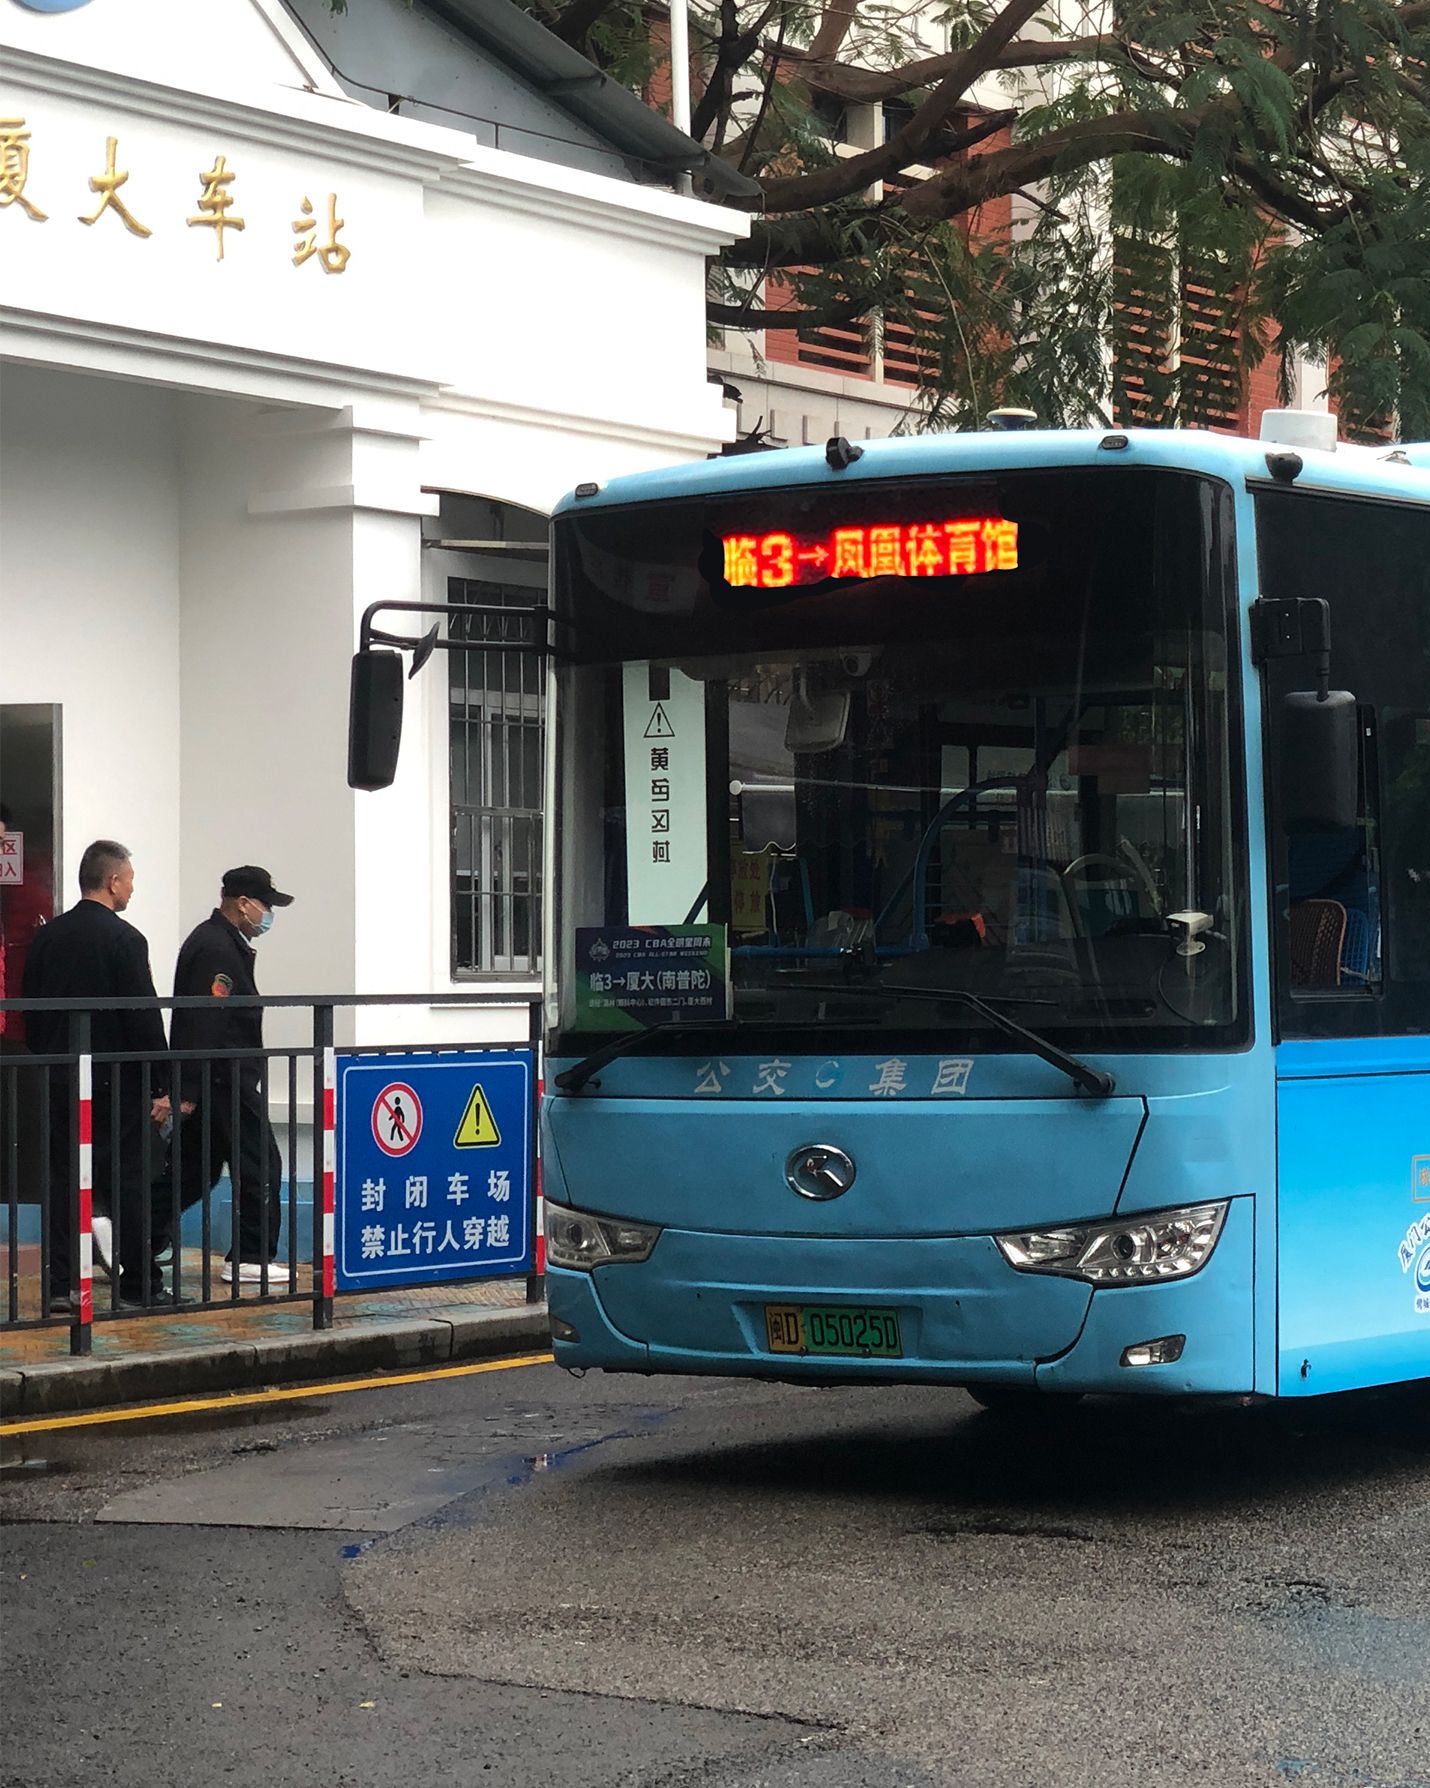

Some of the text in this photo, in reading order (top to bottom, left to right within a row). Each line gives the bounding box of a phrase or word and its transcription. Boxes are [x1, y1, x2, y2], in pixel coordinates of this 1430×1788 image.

[0, 117, 352, 274] 厦大车站
[828, 518, 1018, 578] 凤凰体育馆
[612, 939, 640, 949] 2023
[361, 1169, 510, 1212] 封闭车场
[361, 1214, 510, 1259] 禁止行人穿越
